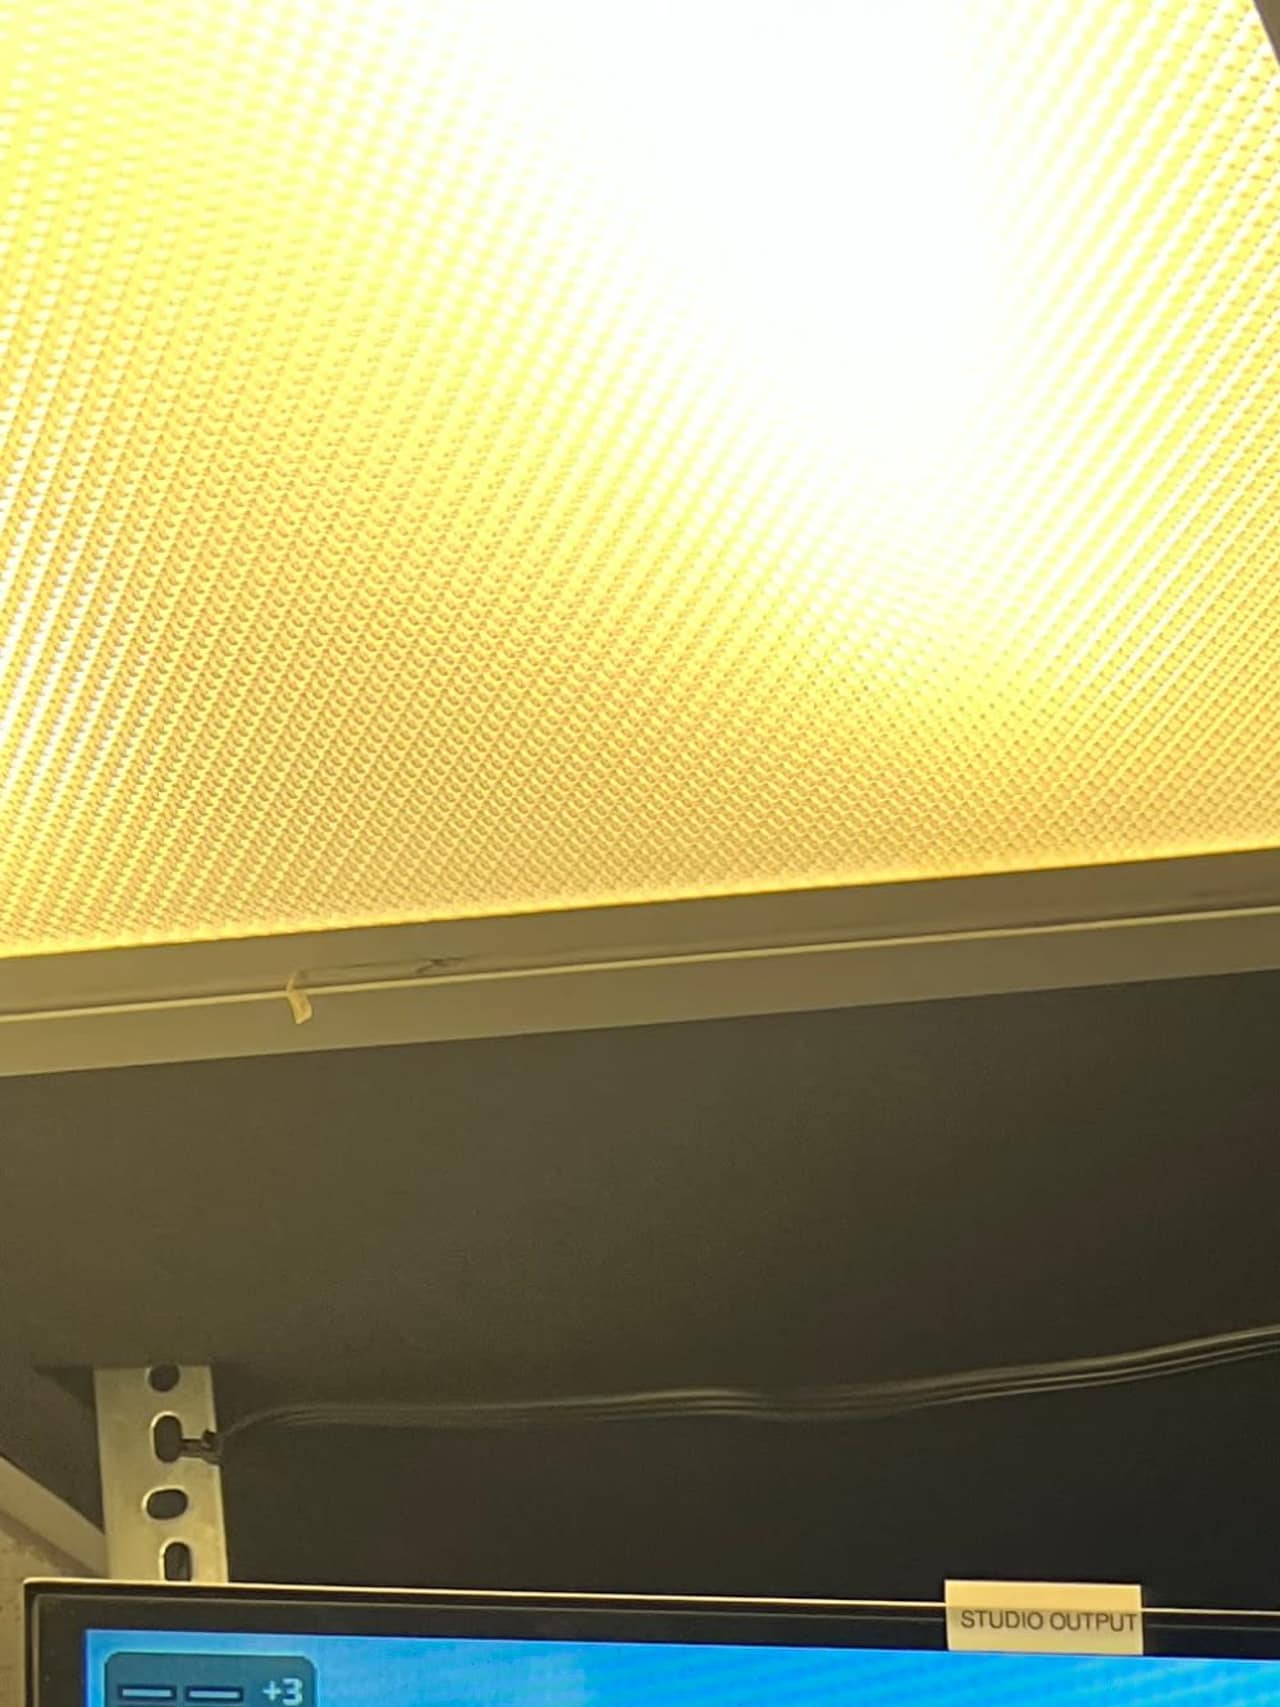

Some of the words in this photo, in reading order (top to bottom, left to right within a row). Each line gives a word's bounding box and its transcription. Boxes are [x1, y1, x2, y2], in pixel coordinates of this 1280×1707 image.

[961, 1610, 1043, 1630] STUDIO
[1050, 1611, 1137, 1632] OUTPUT
[262, 1678, 304, 1707] +3
